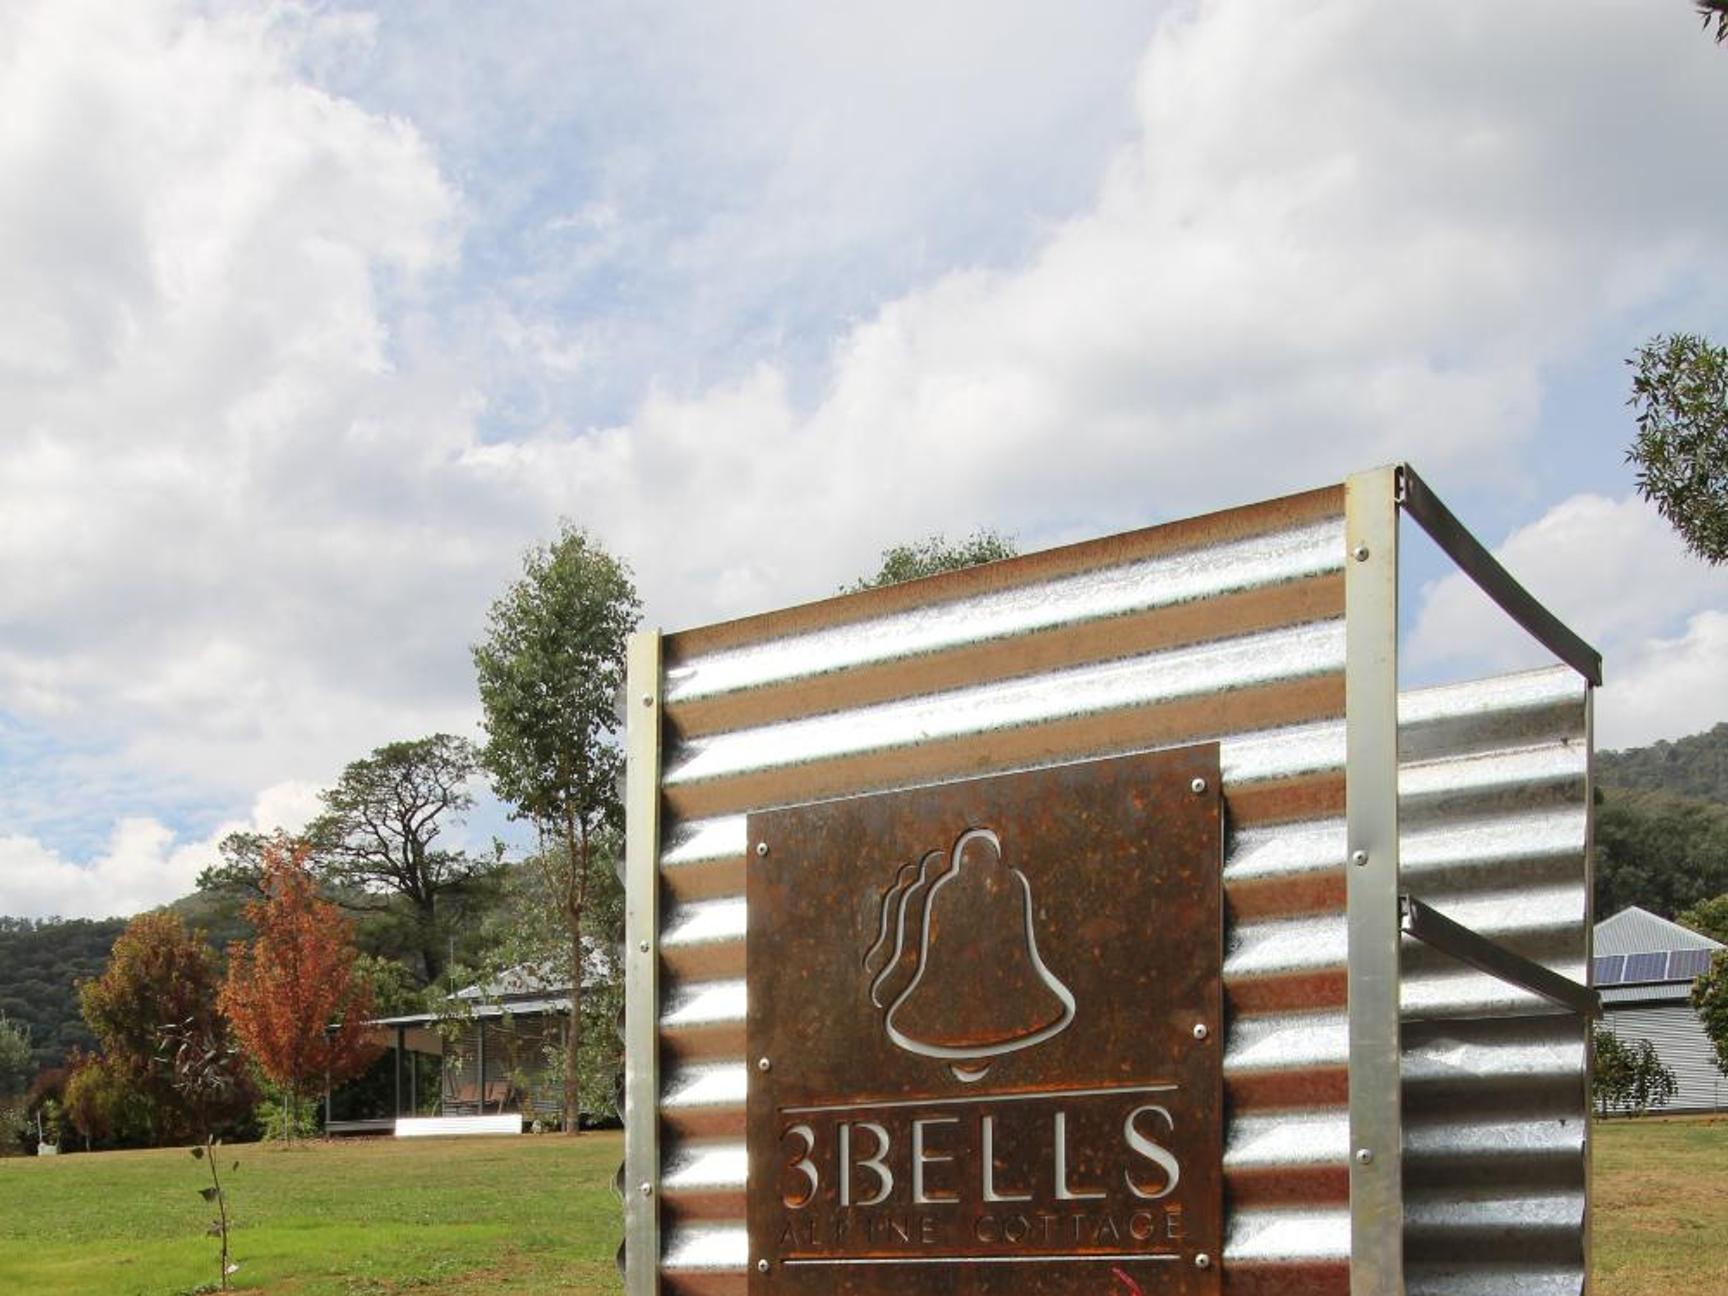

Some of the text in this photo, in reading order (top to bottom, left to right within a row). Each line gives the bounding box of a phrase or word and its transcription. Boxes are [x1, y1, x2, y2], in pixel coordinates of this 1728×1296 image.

[779, 1105, 1180, 1208] 3BELLS
[780, 1212, 1186, 1246] ALPINE COTTAGE
